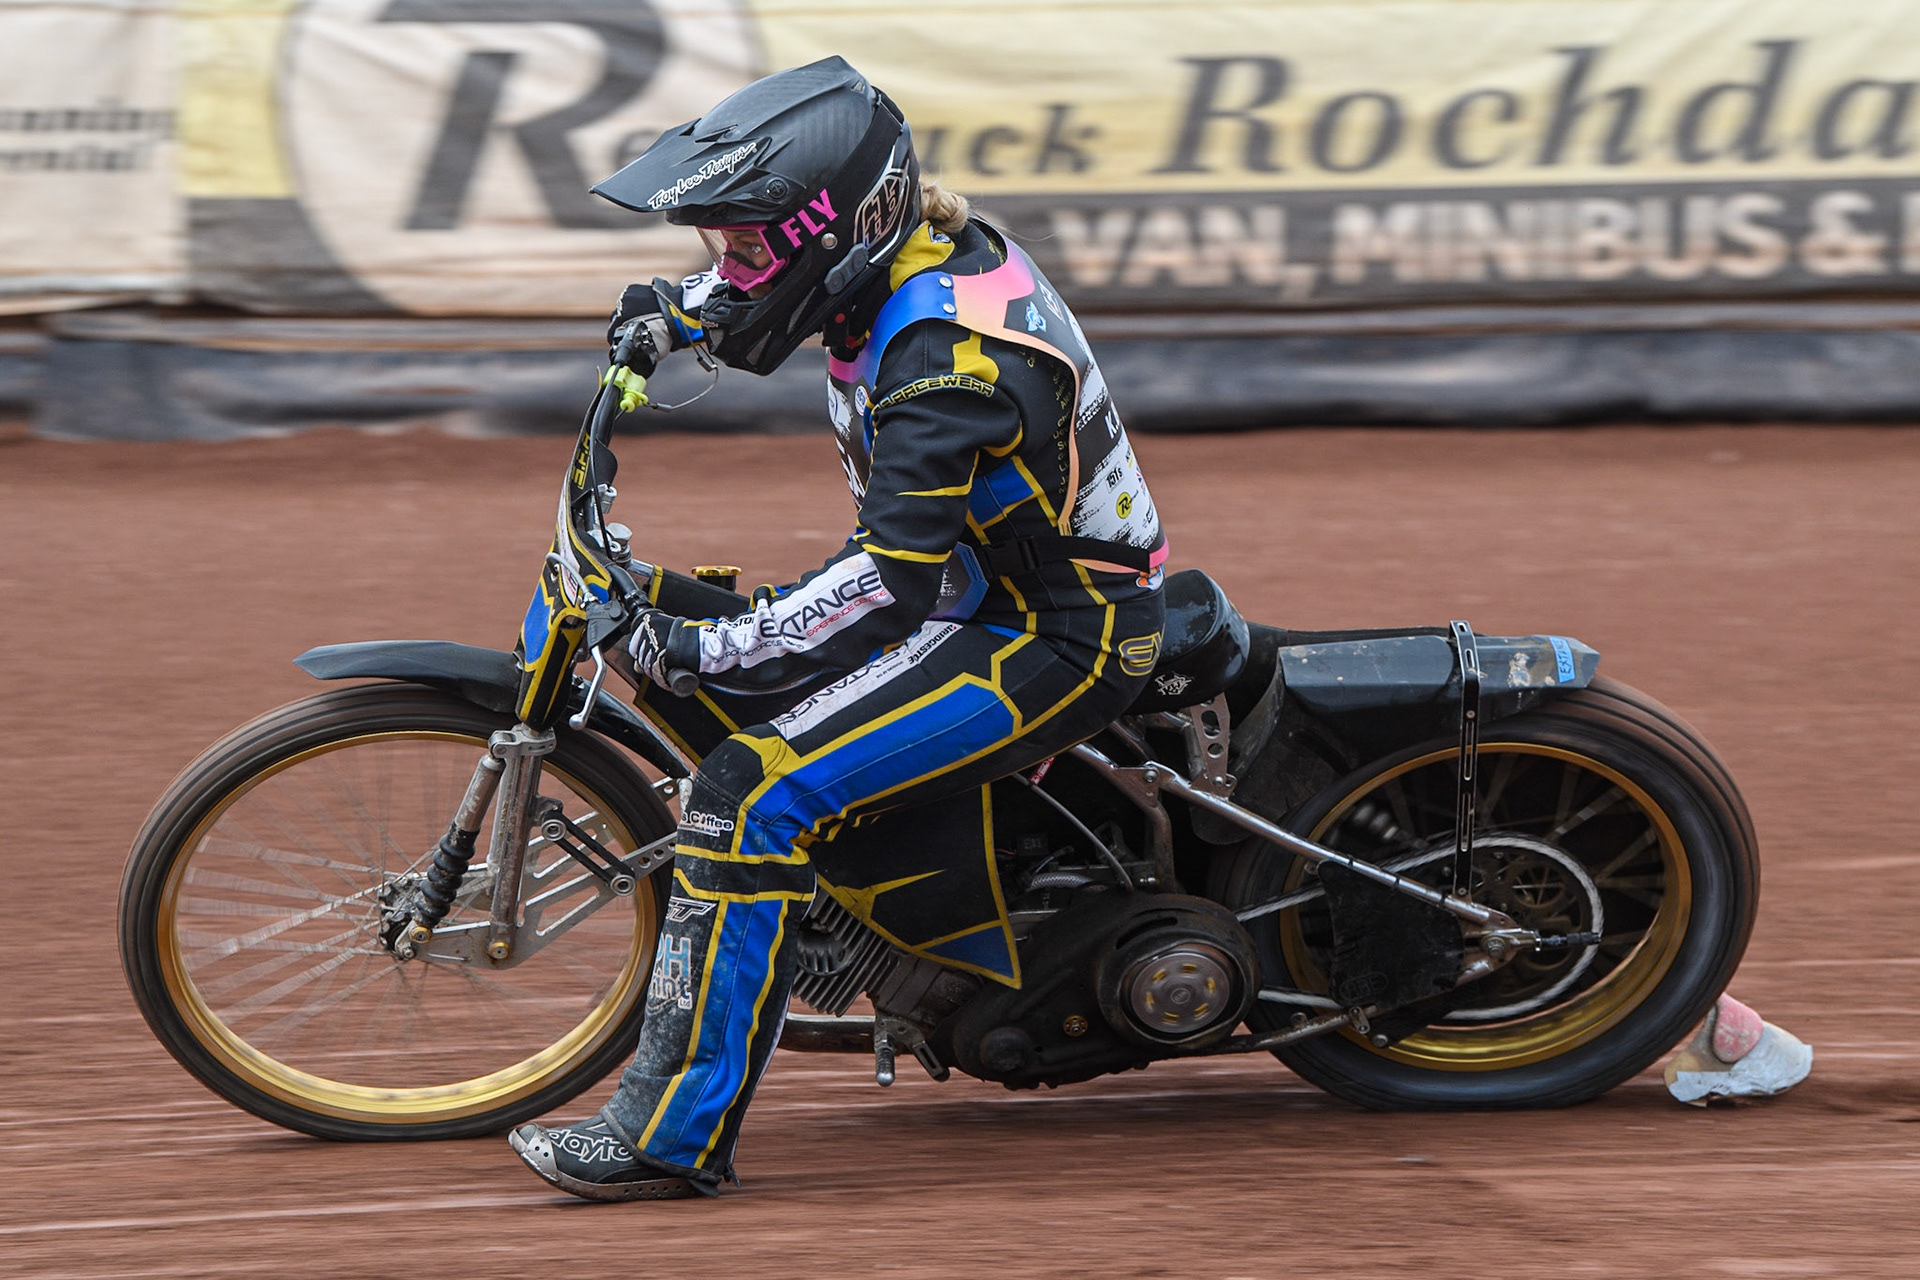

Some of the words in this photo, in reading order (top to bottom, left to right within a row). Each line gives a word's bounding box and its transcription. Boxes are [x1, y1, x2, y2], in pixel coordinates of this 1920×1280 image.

[677, 174, 704, 195] Lee
[778, 188, 839, 248] FLY
[1050, 204, 1319, 298] VAN,
[1334, 193, 1787, 284] MINIBUS
[1805, 190, 1886, 277] &
